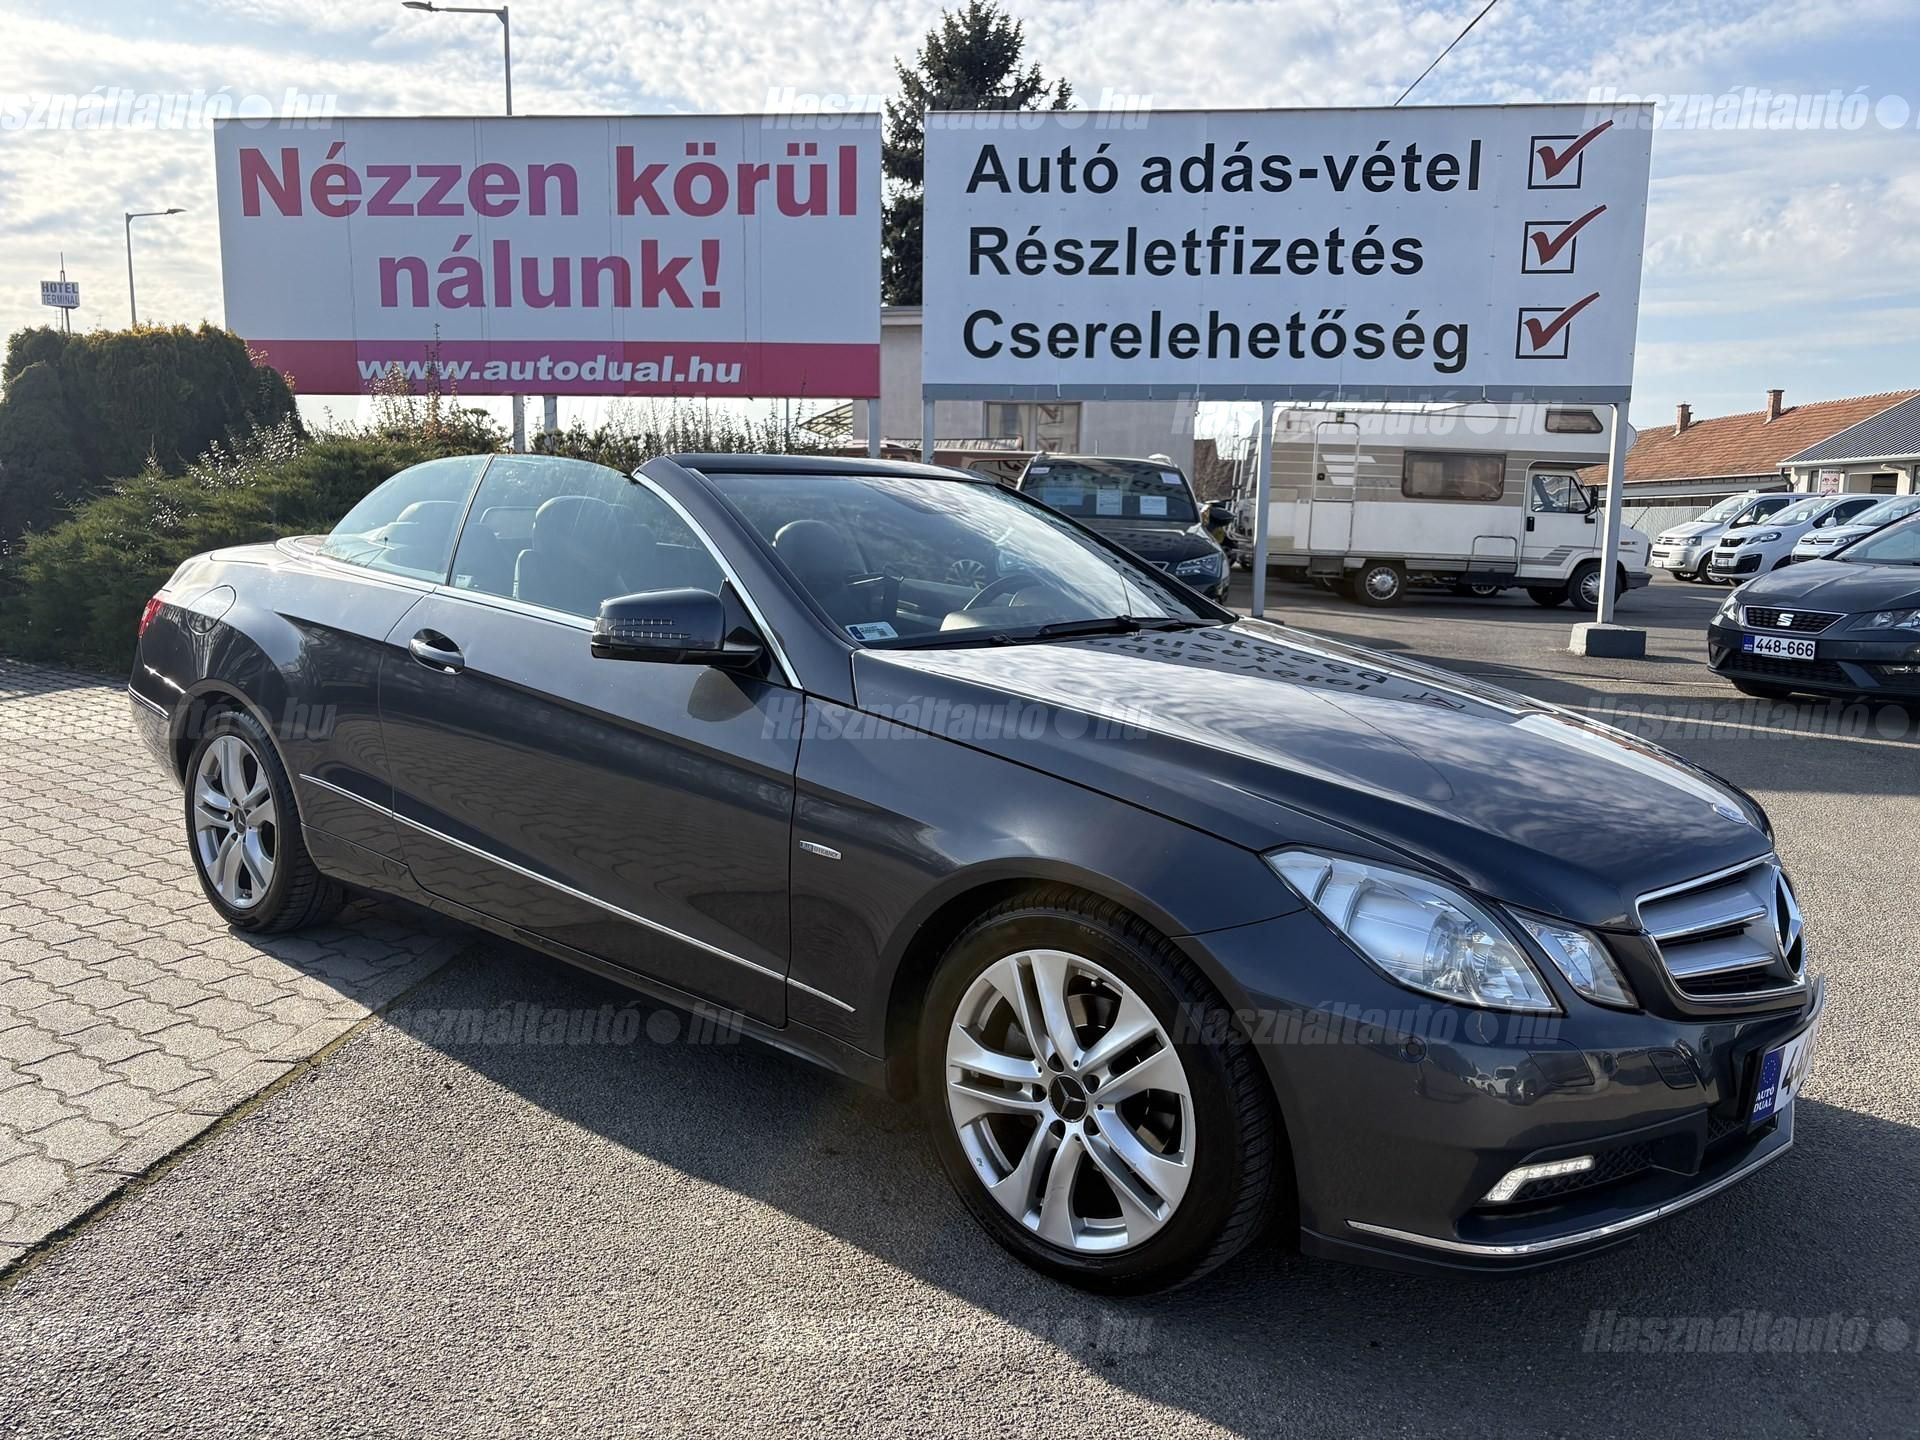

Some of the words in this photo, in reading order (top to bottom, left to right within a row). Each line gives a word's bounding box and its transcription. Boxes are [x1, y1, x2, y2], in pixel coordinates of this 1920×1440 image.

[239, 142, 580, 218] Nézzen
[616, 142, 858, 218] körül
[966, 143, 1119, 194] Autó
[1140, 139, 1483, 194] adás-vétel
[968, 224, 1425, 277] Részletfizetés
[42, 281, 79, 294] HOTEL
[379, 234, 722, 309] nálunk!
[962, 308, 1469, 374] Cserelehetőség
[357, 354, 742, 384] www.autodual.hu
[1755, 638, 1814, 657] 448-666
[1753, 1098, 1773, 1113] DUAL
[1756, 1083, 1775, 1101] AUTÓ
